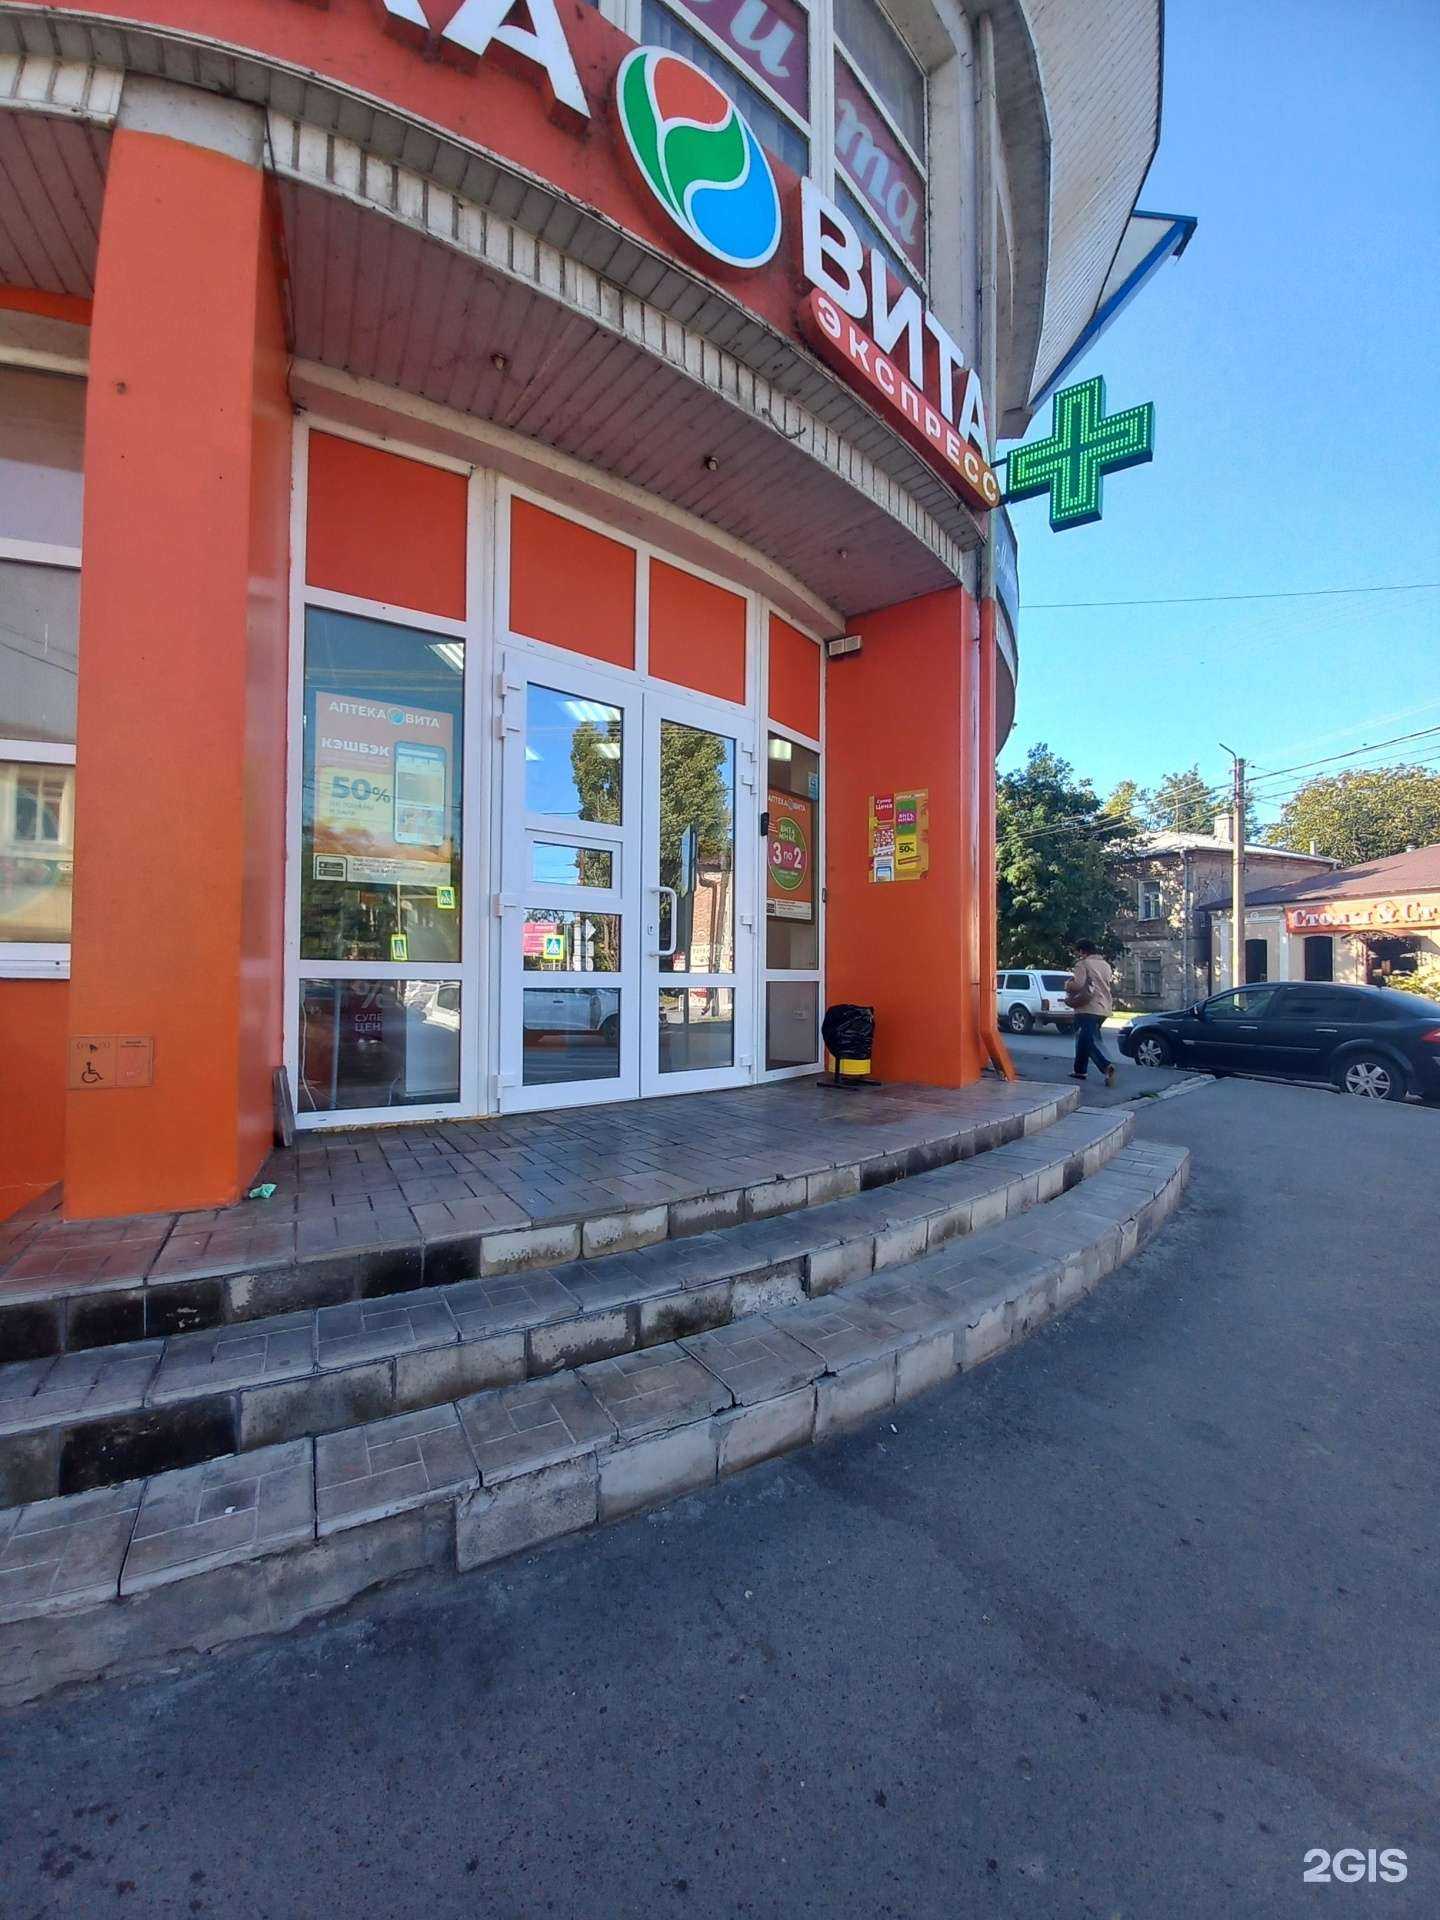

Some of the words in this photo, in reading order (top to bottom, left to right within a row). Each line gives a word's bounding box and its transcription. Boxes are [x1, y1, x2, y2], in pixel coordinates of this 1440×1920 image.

[382, 0, 591, 119] А
[801, 176, 991, 467] ВИТА
[817, 297, 997, 501] ЭКСПРЕСС
[329, 701, 387, 721] АПТЕКА
[405, 713, 440, 728] ВИТА
[321, 737, 390, 757] КЭШБЭК
[331, 776, 392, 803] 50%
[773, 841, 782, 865] 3
[794, 847, 802, 869] 2
